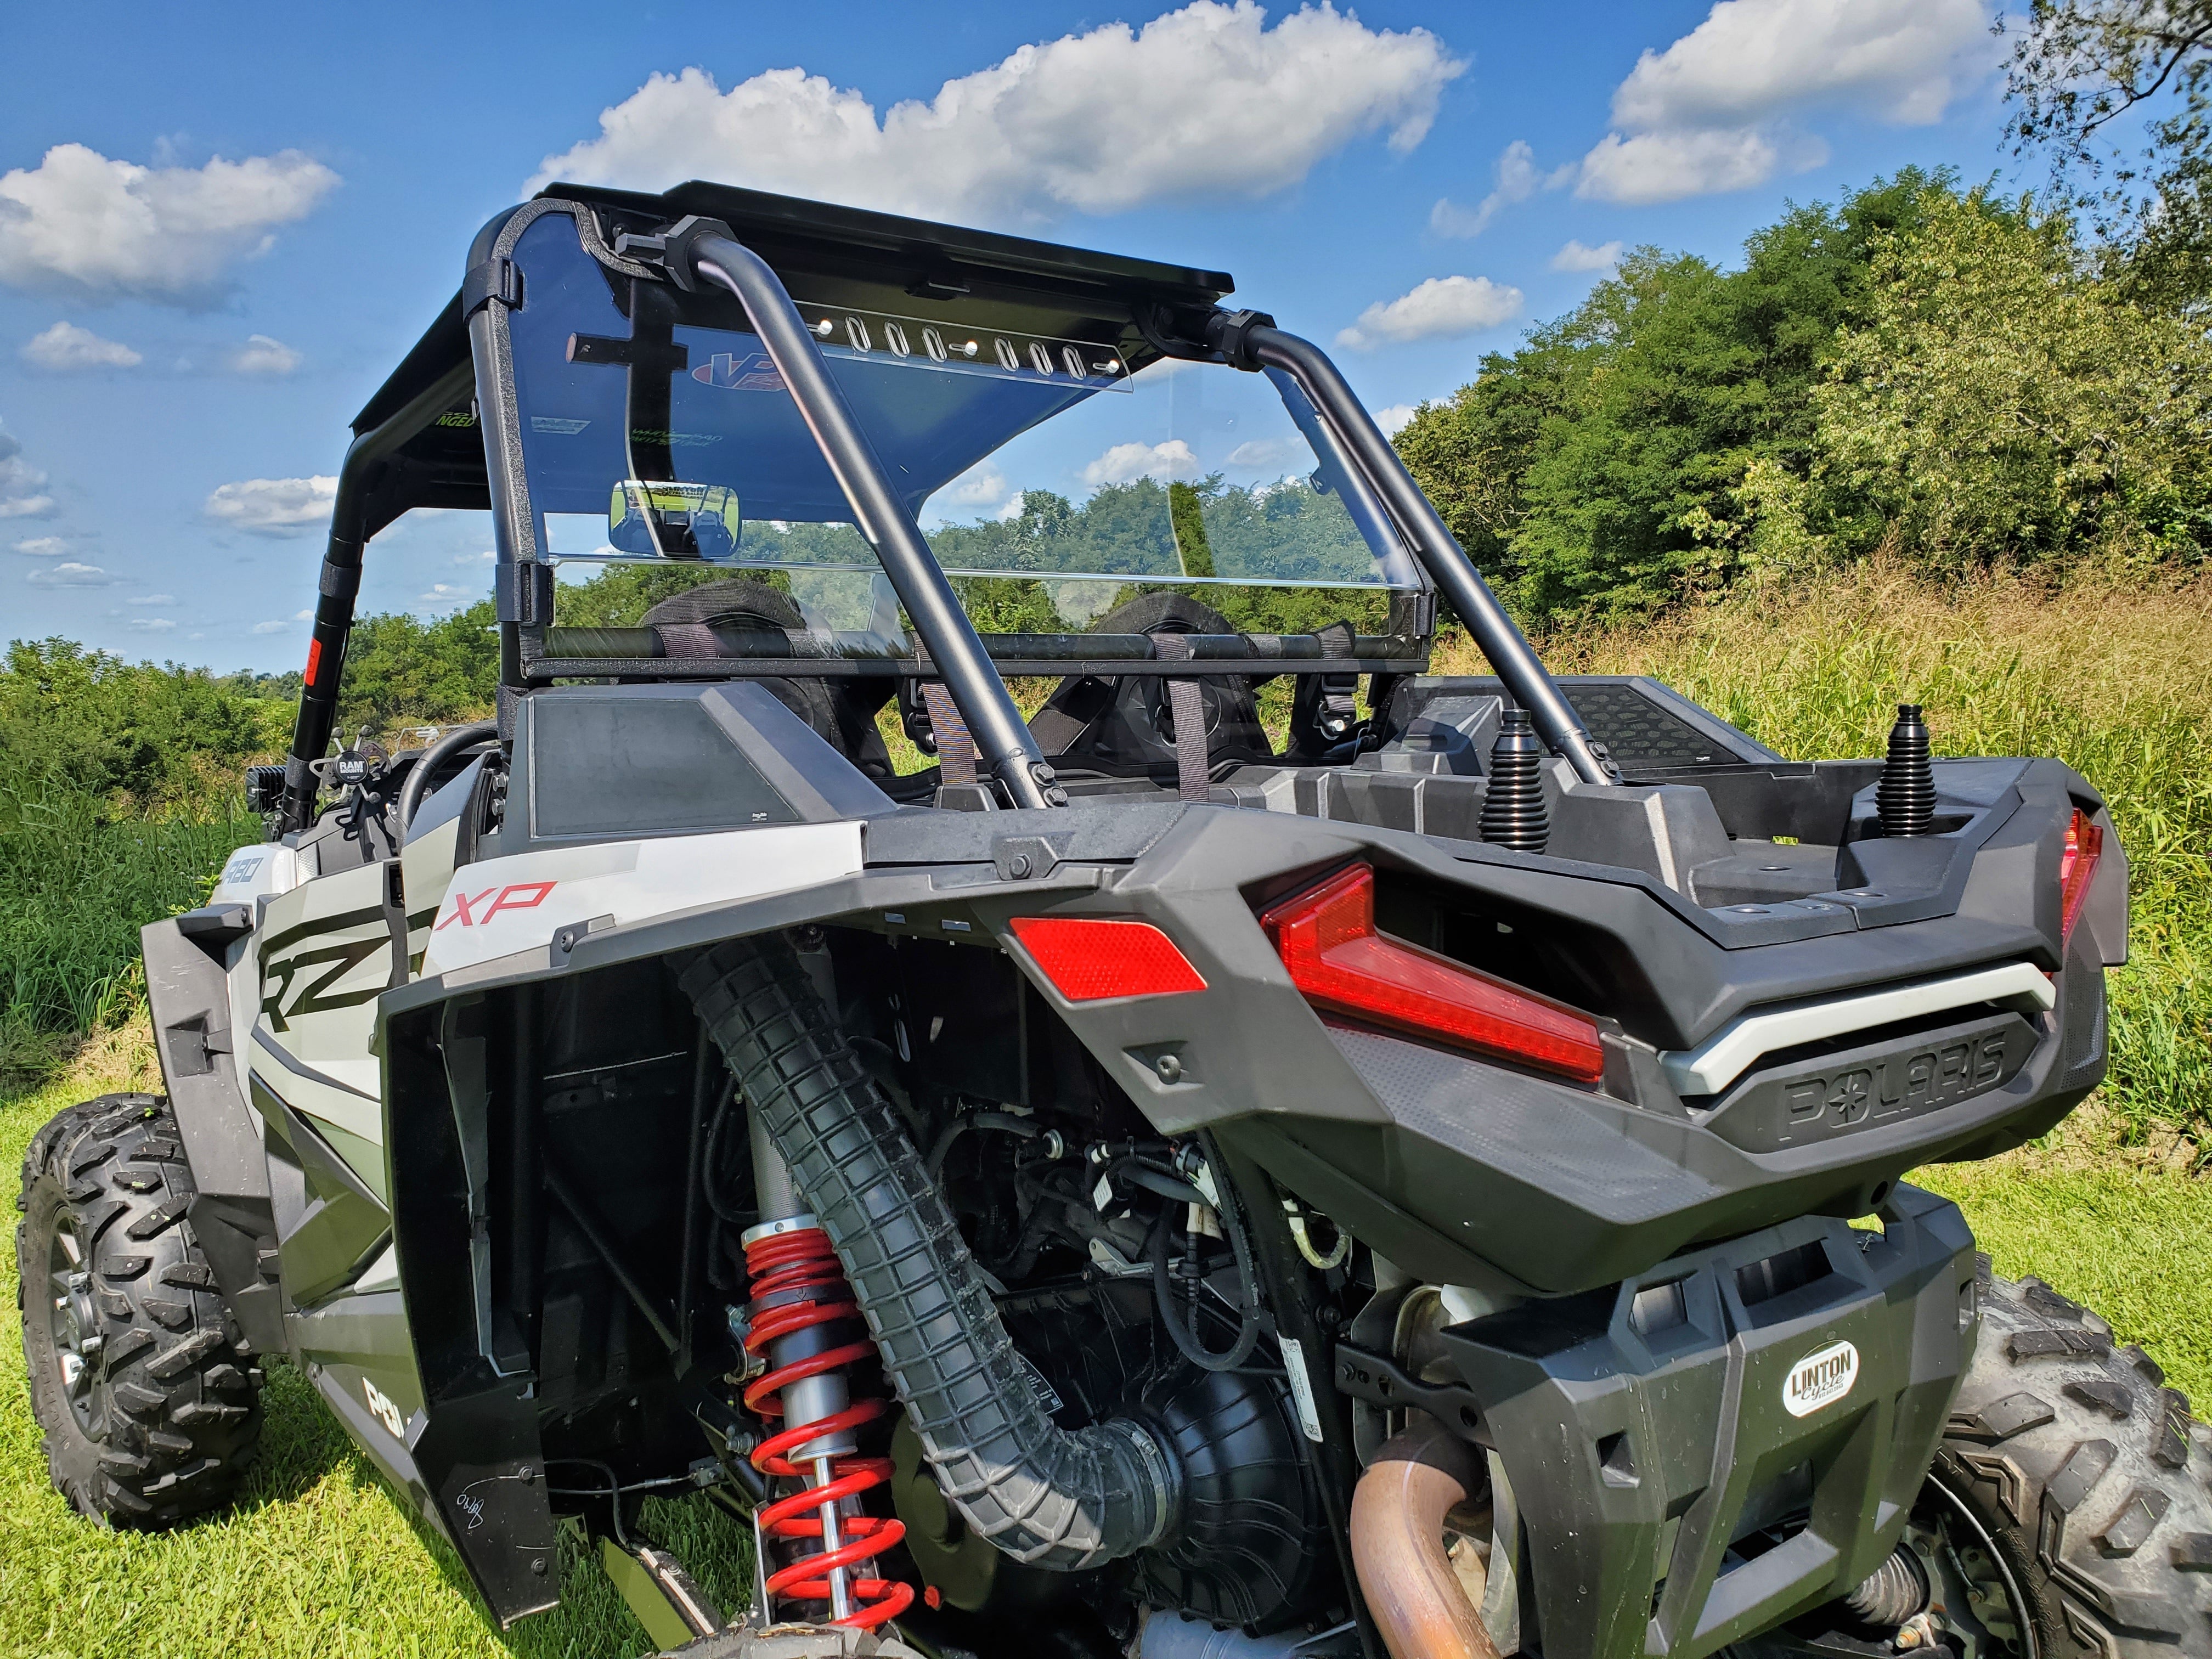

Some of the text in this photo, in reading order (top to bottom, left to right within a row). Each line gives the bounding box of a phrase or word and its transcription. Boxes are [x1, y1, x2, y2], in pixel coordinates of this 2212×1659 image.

[710, 353, 779, 387] VP
[340, 761, 363, 769] RAM
[434, 881, 558, 931] XP
[1779, 1031, 2006, 1141] POLARIS
[1792, 1350, 1850, 1396] LINTON
[1802, 1374, 1844, 1401] Cycle
[363, 1377, 412, 1440] POL
